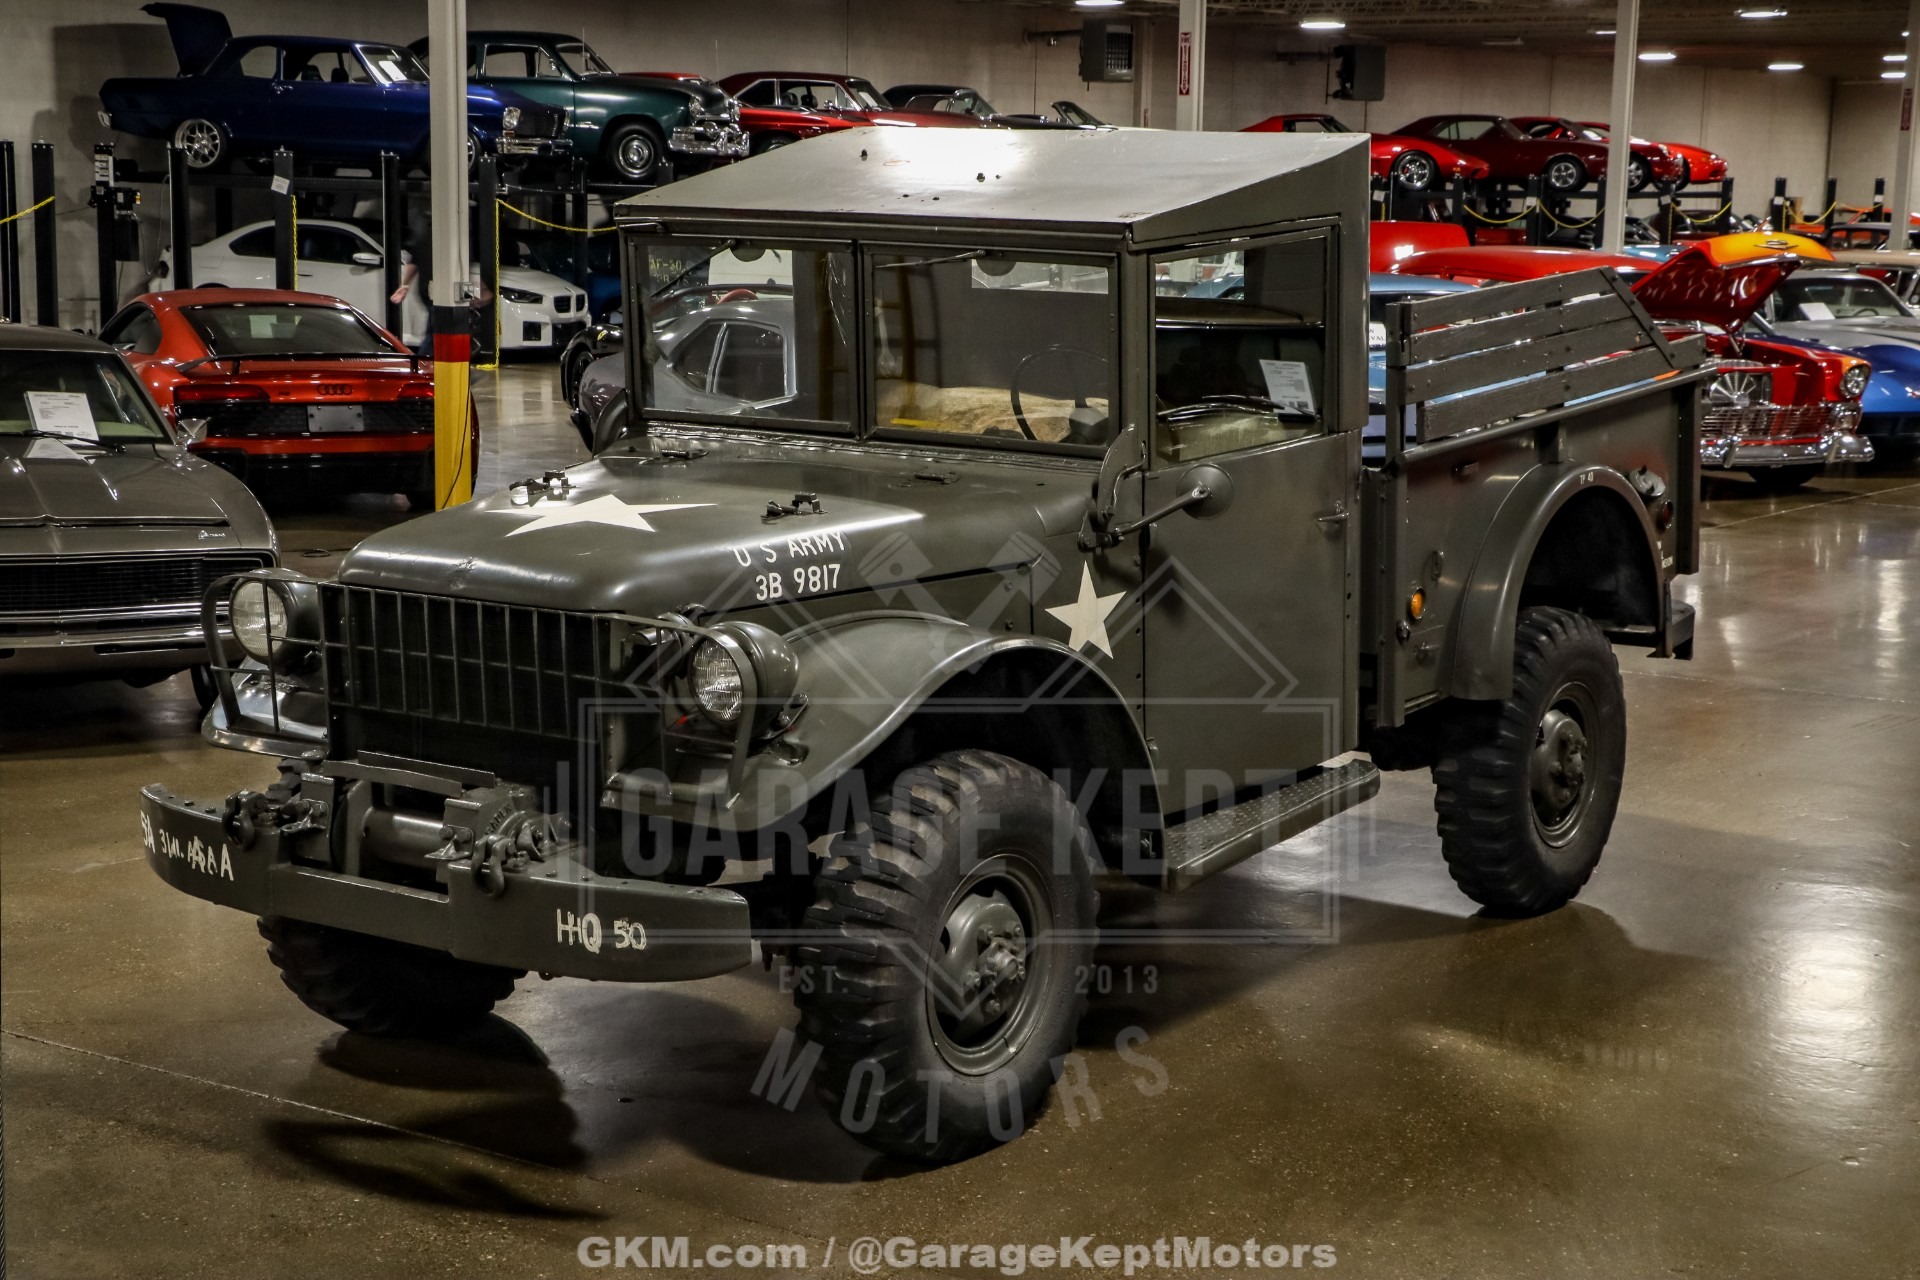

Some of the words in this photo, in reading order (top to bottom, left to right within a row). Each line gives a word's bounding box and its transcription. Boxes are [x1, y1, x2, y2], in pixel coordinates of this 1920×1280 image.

[732, 546, 751, 567] U
[759, 543, 777, 563] S
[787, 529, 846, 558] ARMY
[755, 572, 783, 601] 3B
[793, 563, 841, 594] 9817
[613, 917, 647, 950] 50
